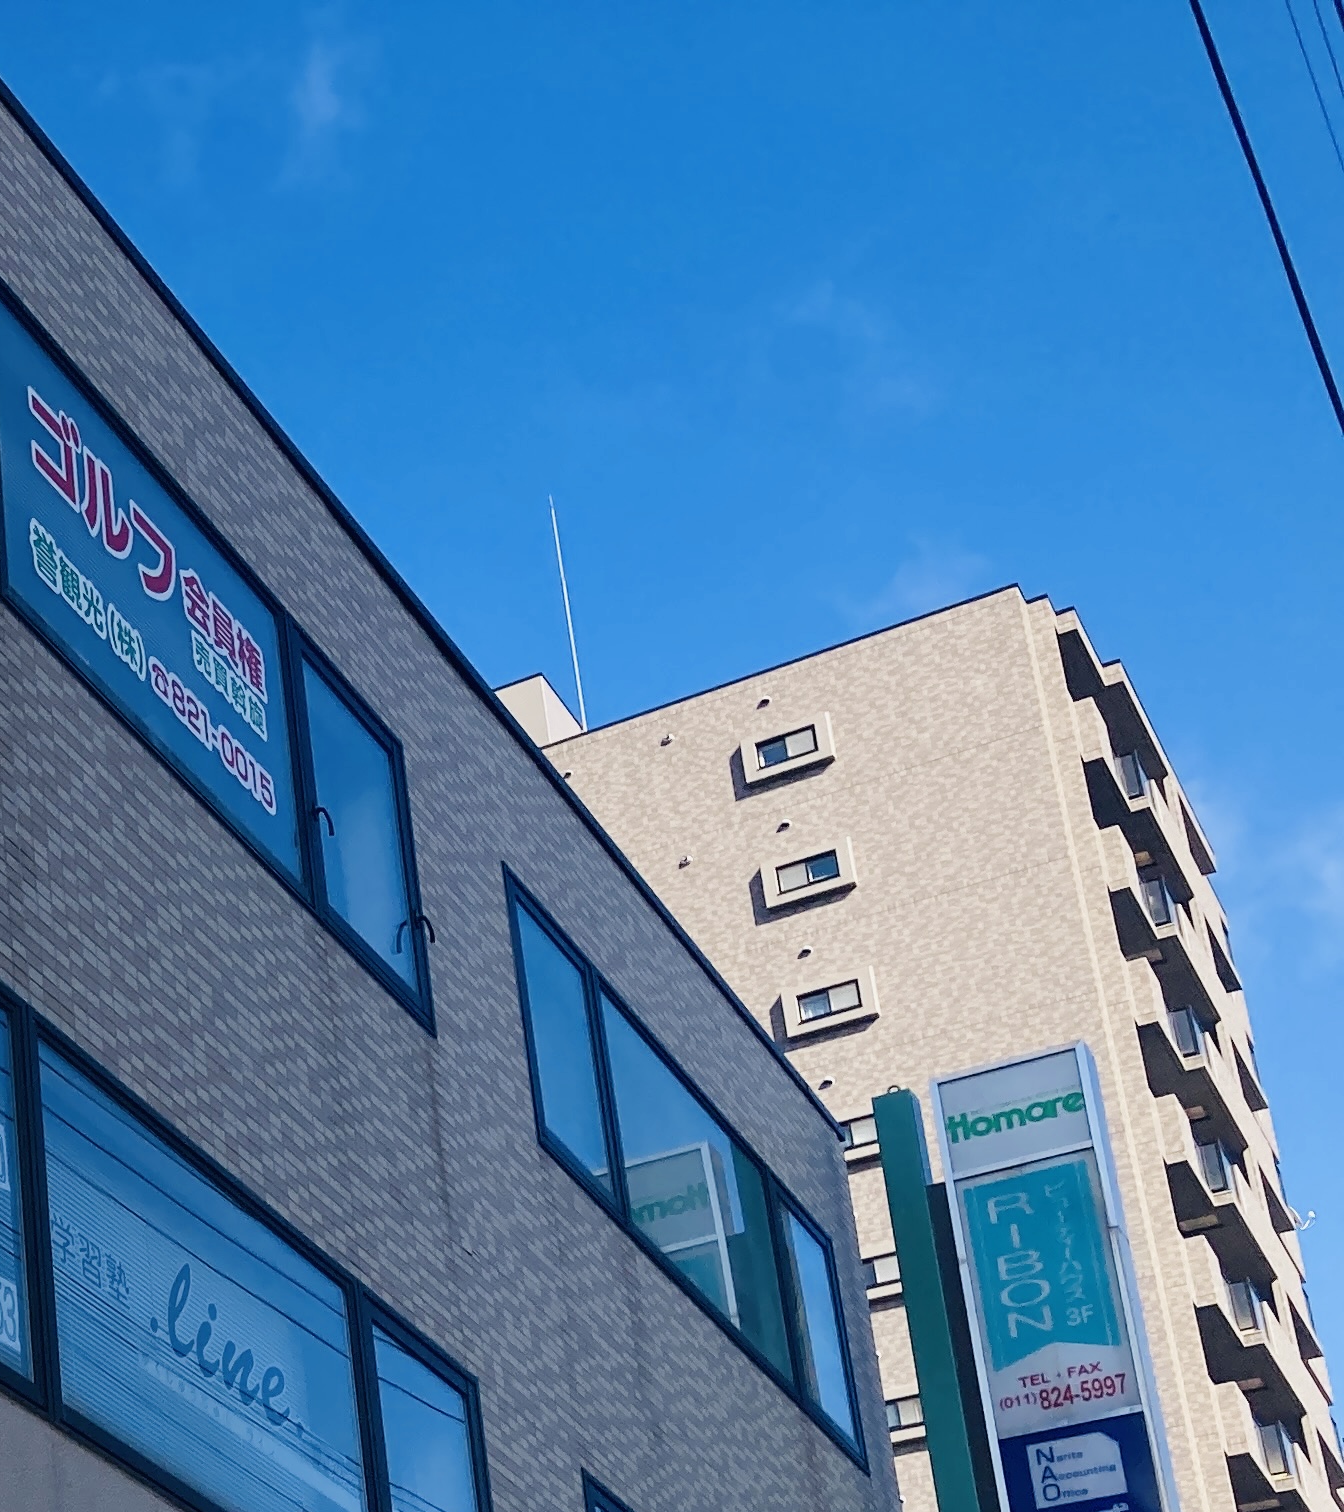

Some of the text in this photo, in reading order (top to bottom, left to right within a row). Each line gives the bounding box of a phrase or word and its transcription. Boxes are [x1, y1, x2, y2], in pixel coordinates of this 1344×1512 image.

[30, 388, 175, 598] ゴルフ
[181, 571, 266, 699] 会員権
[172, 682, 274, 812] 821-0015
[946, 1090, 1086, 1144] Homare
[51, 1212, 130, 1304] 学習塾
[987, 1191, 1055, 1340] RIBON
[1066, 1303, 1094, 1327] 3F
[1018, 1361, 1104, 1389] TEL FAX
